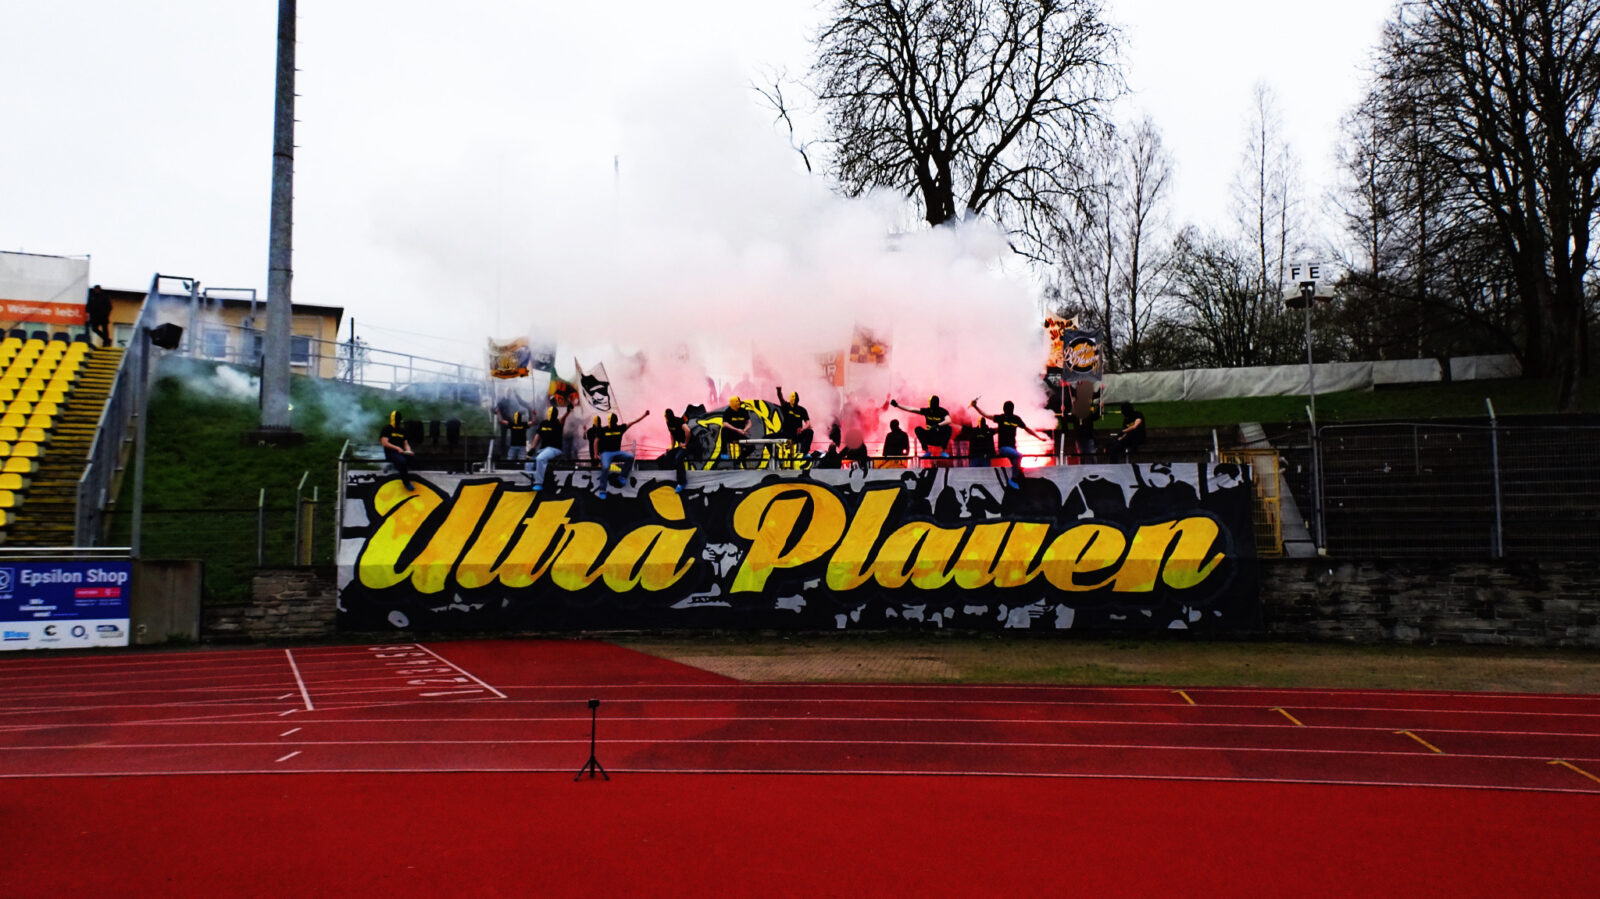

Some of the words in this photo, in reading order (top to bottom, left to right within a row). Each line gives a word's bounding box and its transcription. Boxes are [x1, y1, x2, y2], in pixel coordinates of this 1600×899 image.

[1291, 267, 1301, 281] F
[1309, 266, 1320, 279] E
[730, 483, 1226, 593] Plauen
[20, 568, 82, 587] Epsilon
[86, 568, 128, 586] Shop
